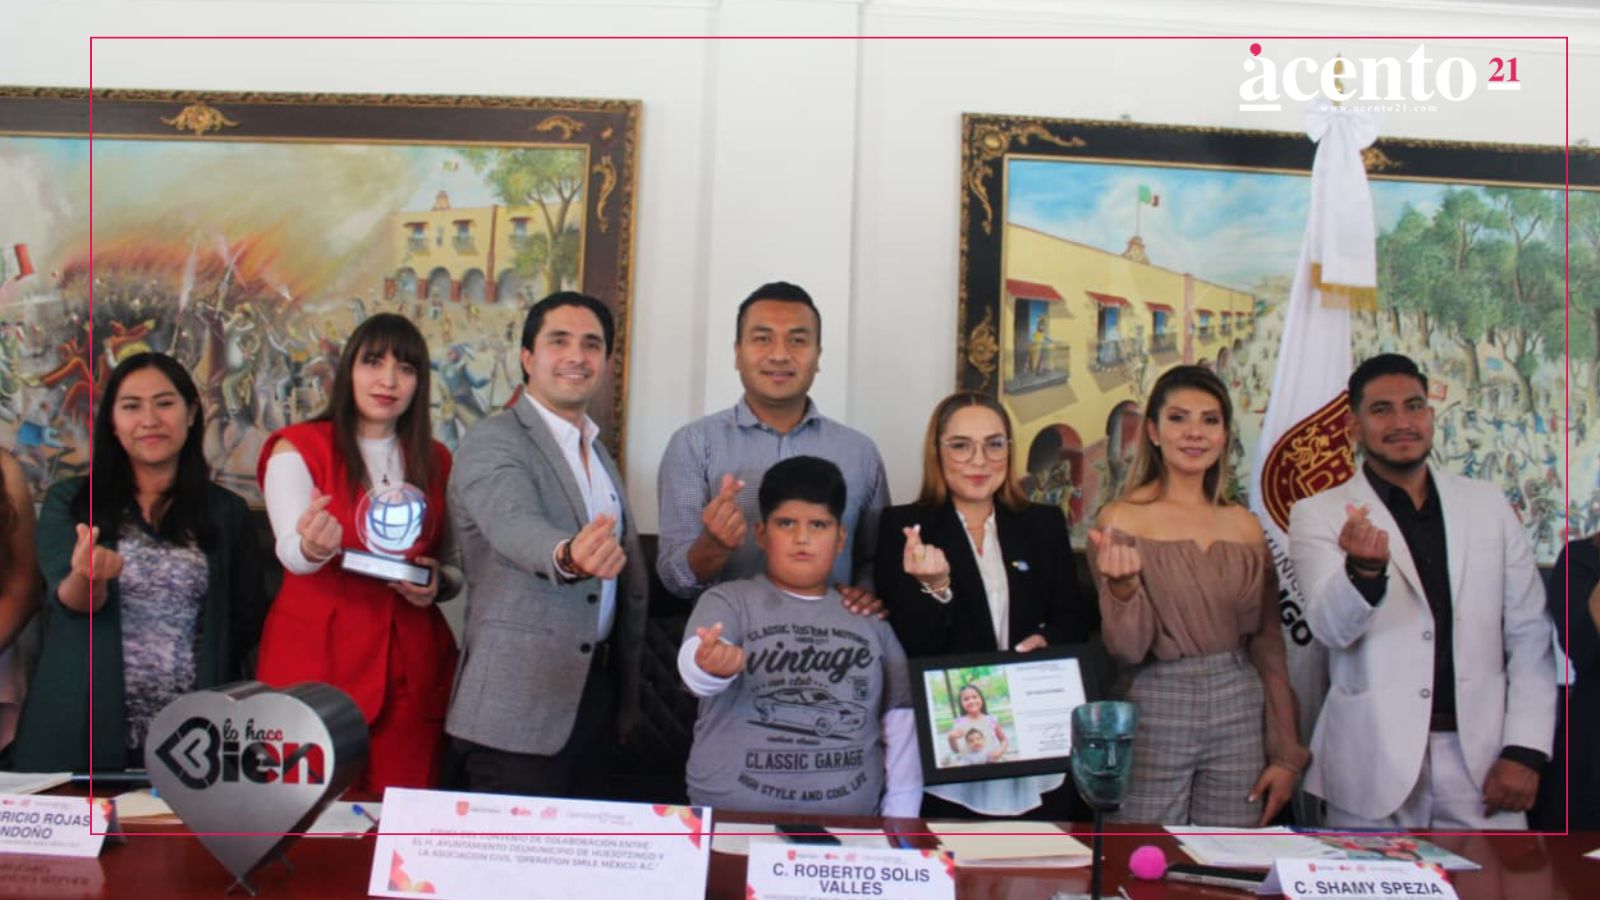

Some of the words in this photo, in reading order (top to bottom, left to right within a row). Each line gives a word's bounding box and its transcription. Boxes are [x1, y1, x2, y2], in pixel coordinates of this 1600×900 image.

[747, 641, 874, 683] vintage
[223, 719, 239, 740] lo
[245, 718, 284, 741] hace
[745, 752, 808, 770] CLASSIC
[814, 749, 864, 769] GARAGE
[761, 784, 796, 800] STYLE
[799, 789, 824, 801] AND
[43, 813, 91, 827] ROJAS
[773, 862, 788, 877] C.
[795, 864, 876, 880] ROBERTO
[881, 867, 930, 882] SOLIS
[820, 880, 883, 895] VALLES
[1294, 881, 1312, 895] C.
[1316, 881, 1375, 895] SHAMY
[1381, 882, 1443, 896] SPEZIA
